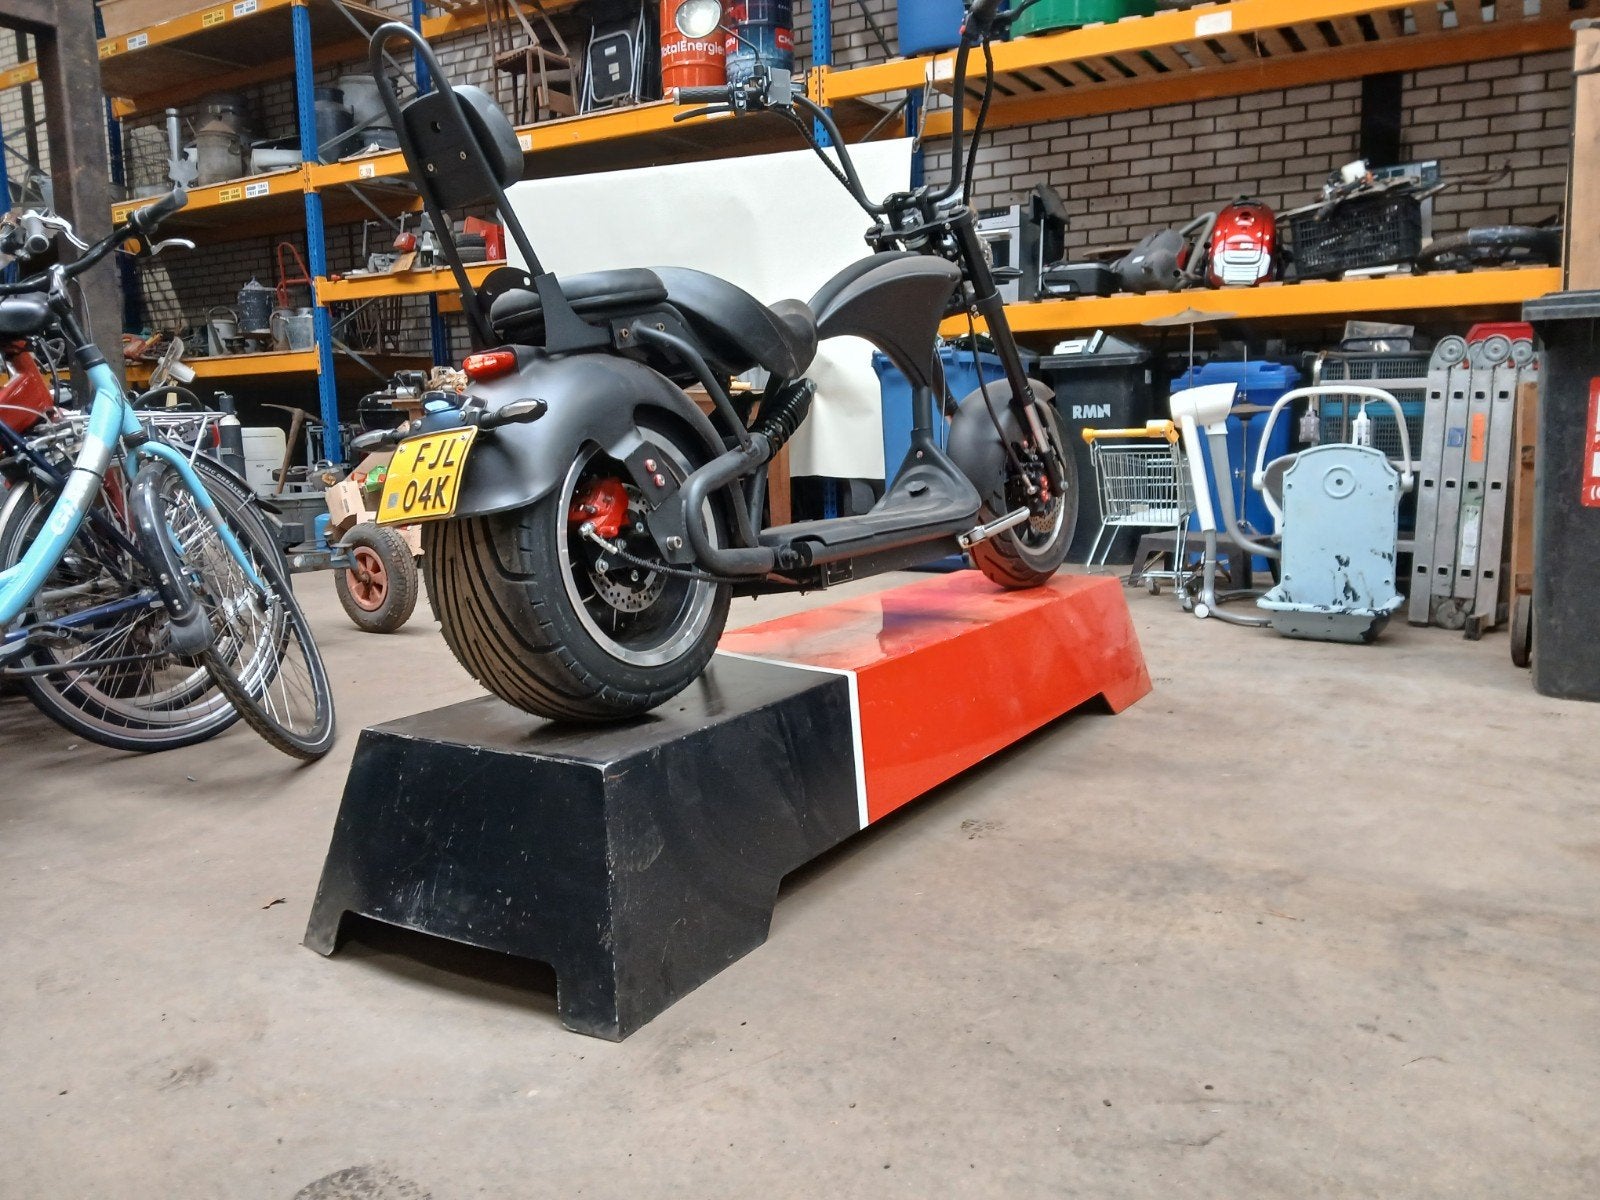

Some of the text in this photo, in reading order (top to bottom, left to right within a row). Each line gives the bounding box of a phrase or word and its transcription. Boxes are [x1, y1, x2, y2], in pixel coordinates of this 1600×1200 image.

[661, 38, 724, 57] otalEnergie
[1072, 403, 1111, 420] RMN
[411, 438, 457, 473] FJL
[403, 475, 451, 513] 04K
